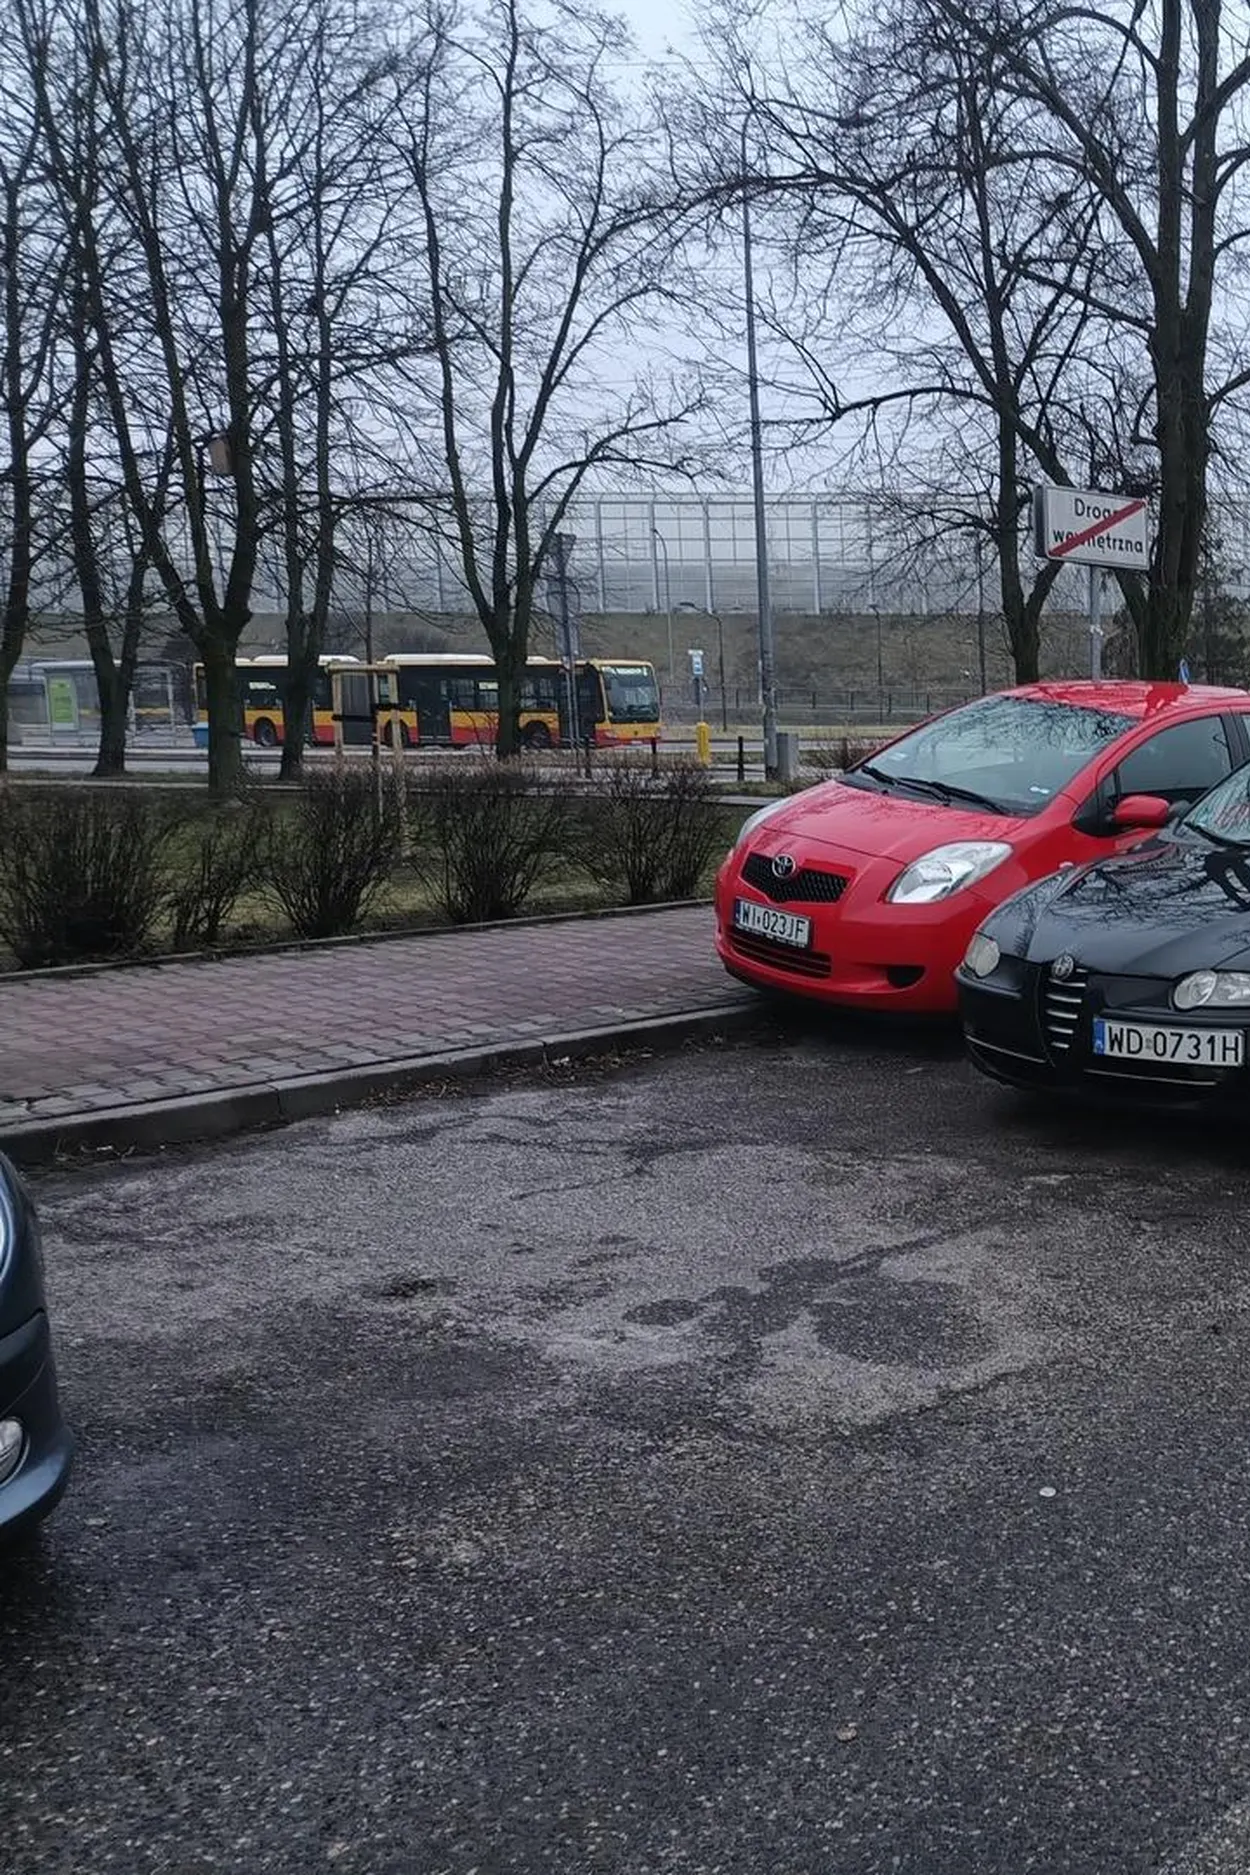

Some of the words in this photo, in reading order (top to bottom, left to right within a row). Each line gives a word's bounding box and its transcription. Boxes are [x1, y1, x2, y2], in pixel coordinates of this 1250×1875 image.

[1074, 498, 1121, 522] Drog
[1053, 530, 1143, 553] wnętrzna
[1108, 1026, 1143, 1055] WD
[1153, 1031, 1240, 1062] 0731H
